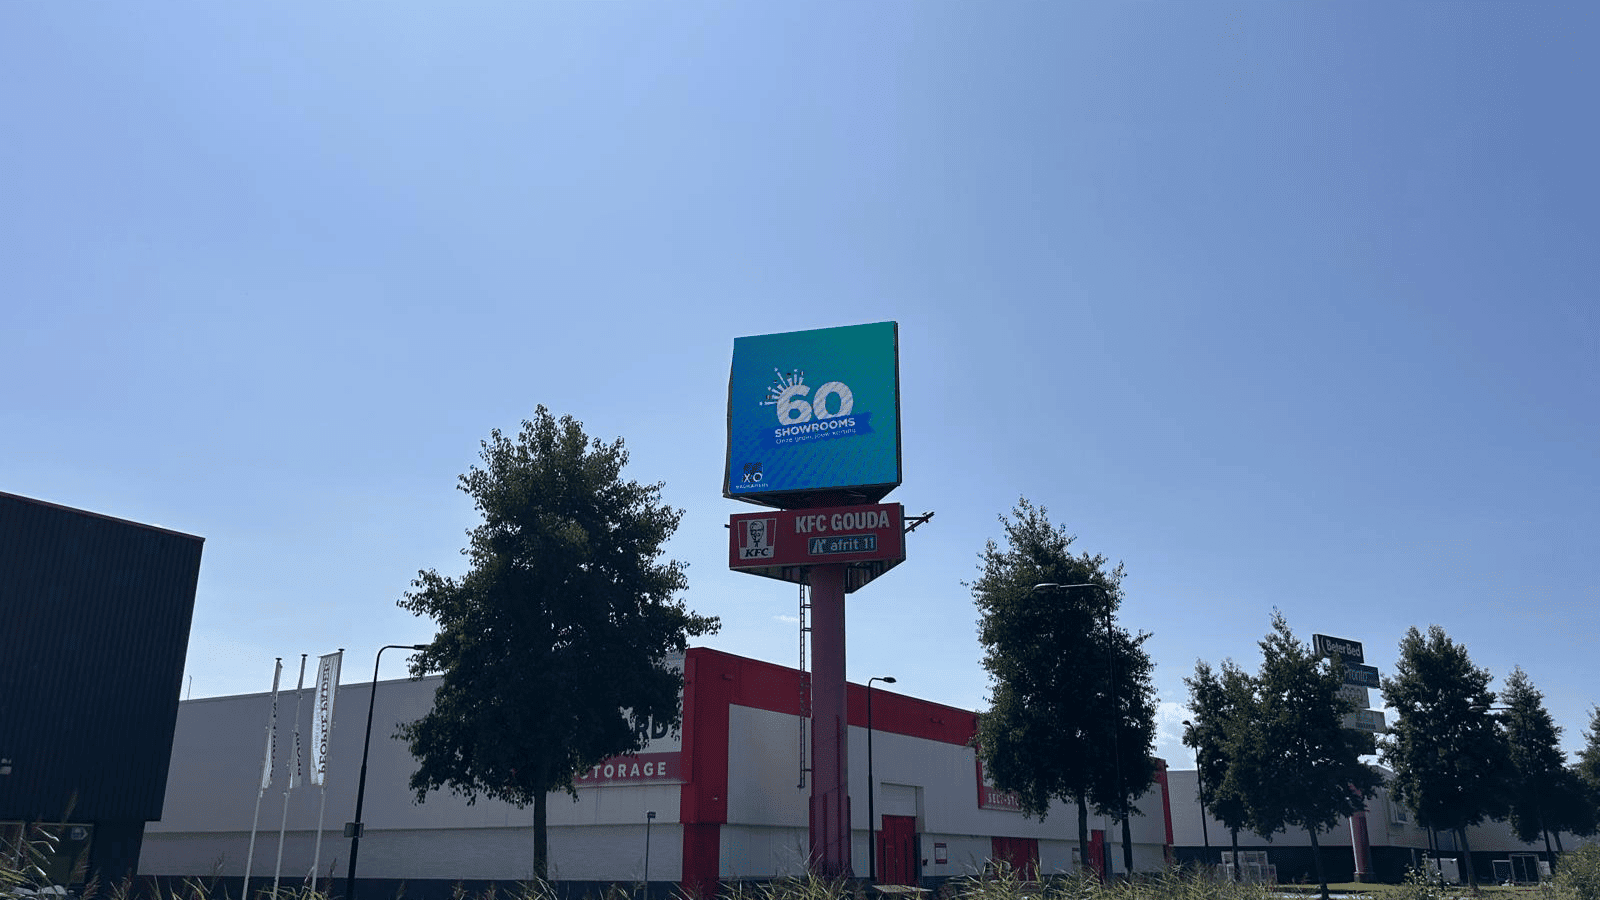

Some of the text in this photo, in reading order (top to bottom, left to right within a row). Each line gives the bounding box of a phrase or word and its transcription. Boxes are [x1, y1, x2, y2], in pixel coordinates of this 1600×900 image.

[776, 381, 854, 426] 60
[774, 417, 856, 438] SHOWROOMS
[795, 510, 890, 534] KFC GOUDA
[745, 547, 769, 557] KFC
[830, 536, 875, 552] afrit 11
[580, 761, 667, 780] TORAGE
